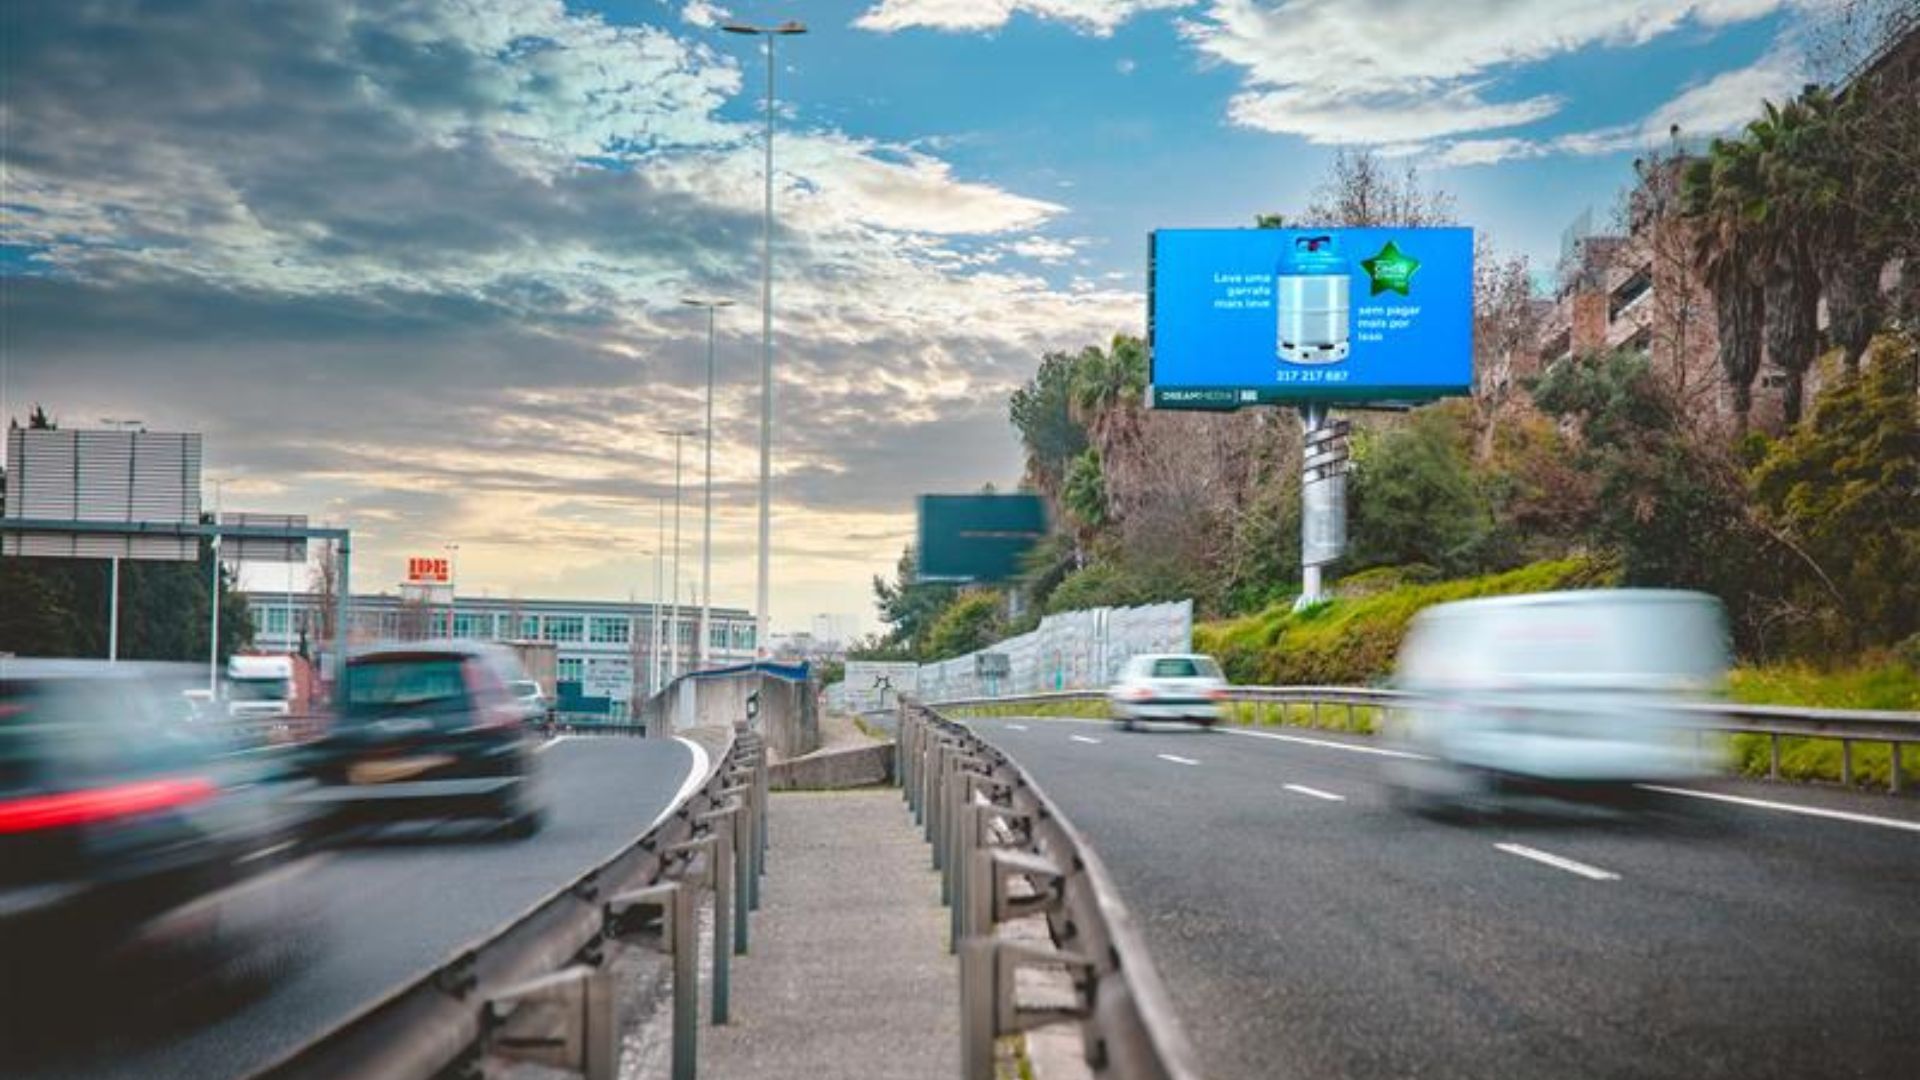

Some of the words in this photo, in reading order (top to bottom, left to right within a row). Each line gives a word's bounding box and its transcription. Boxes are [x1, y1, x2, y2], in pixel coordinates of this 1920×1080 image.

[1214, 272, 1241, 283] Leve
[1245, 274, 1271, 283] uma
[1227, 286, 1271, 297] garrafa
[1359, 306, 1385, 315] sem
[1386, 306, 1420, 317] pagar
[1358, 318, 1386, 328] mais
[1388, 319, 1409, 329] por
